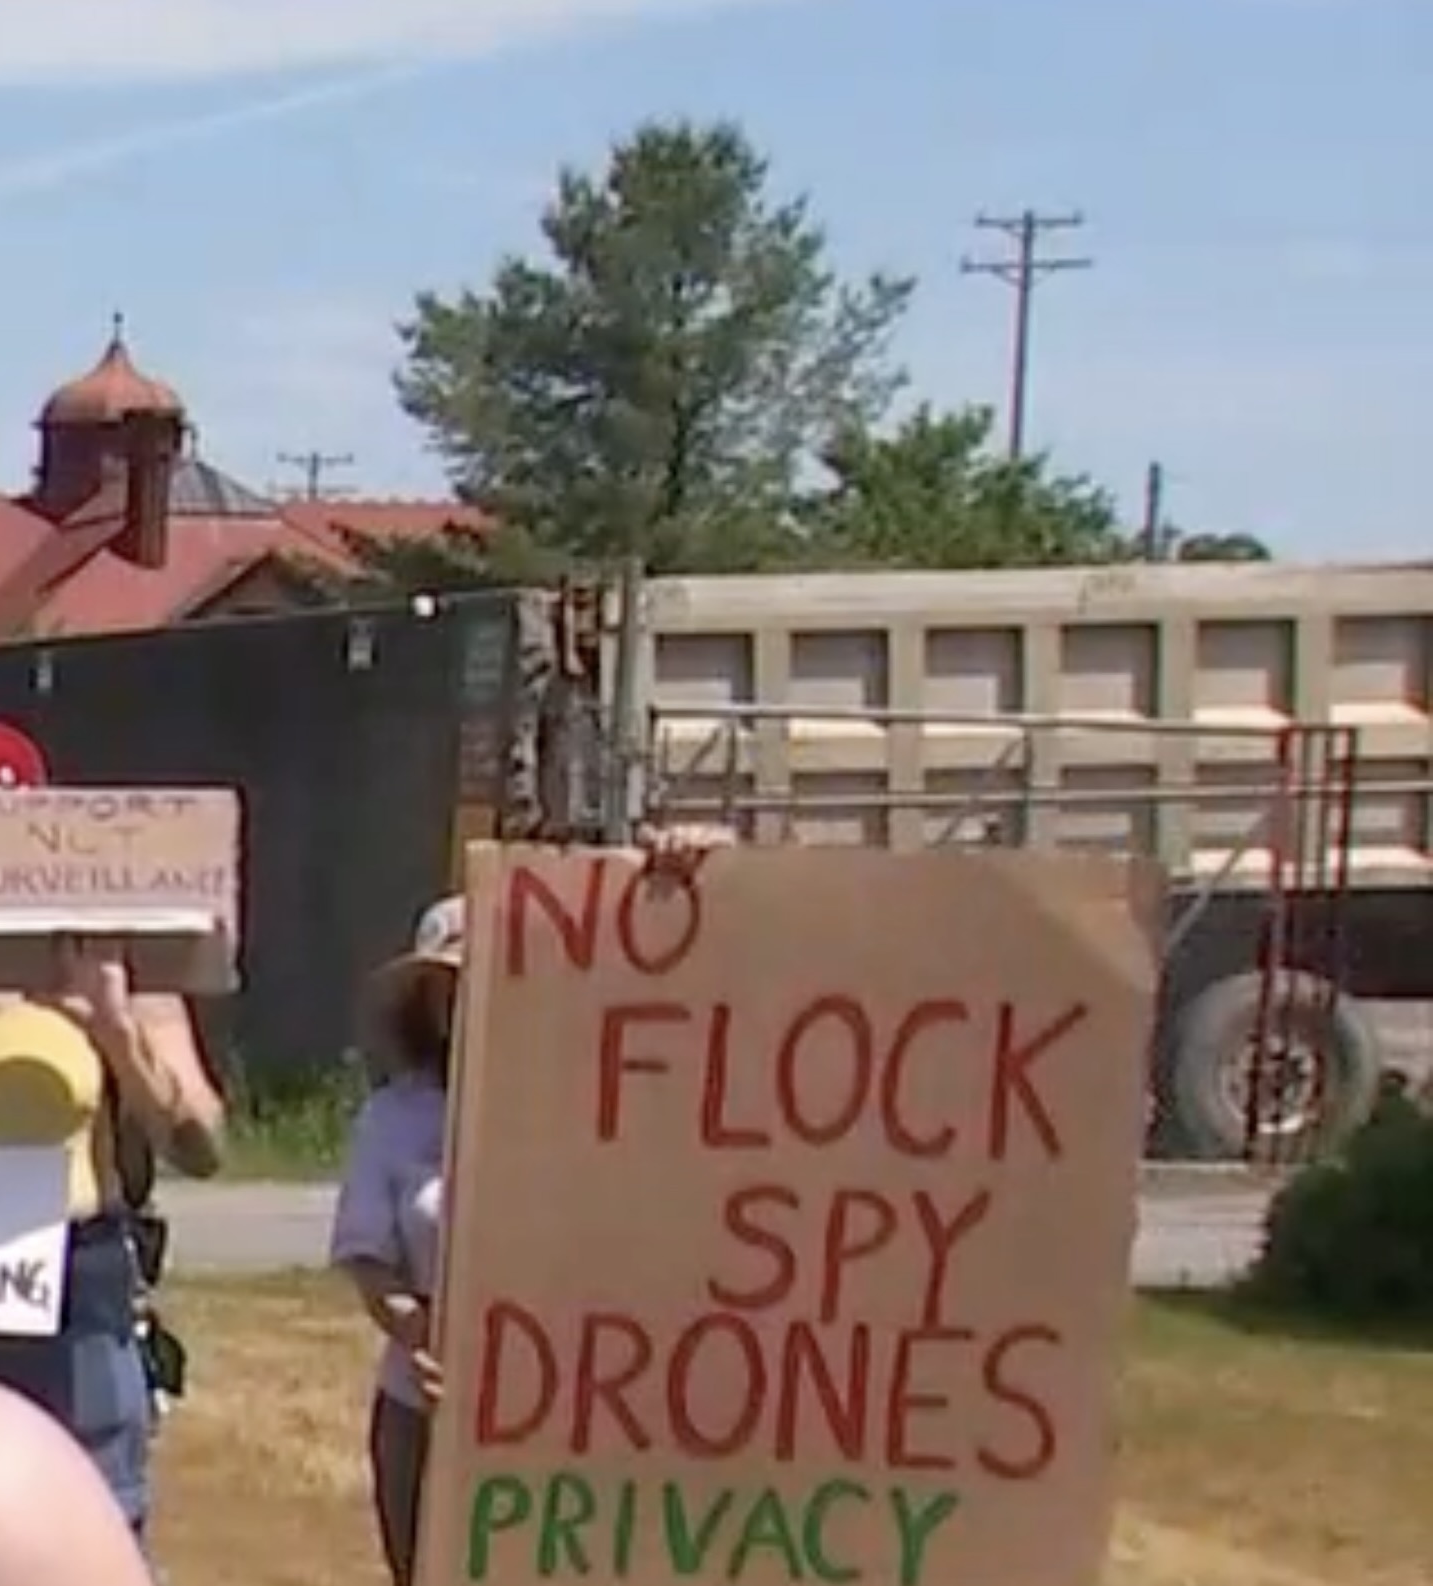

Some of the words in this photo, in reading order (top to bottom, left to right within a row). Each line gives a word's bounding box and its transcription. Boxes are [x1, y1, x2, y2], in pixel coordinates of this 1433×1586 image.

[506, 858, 700, 977] NO
[594, 994, 1088, 1160] FLOCK
[706, 1184, 992, 1332] SPY
[474, 1298, 1062, 1480] DRONES
